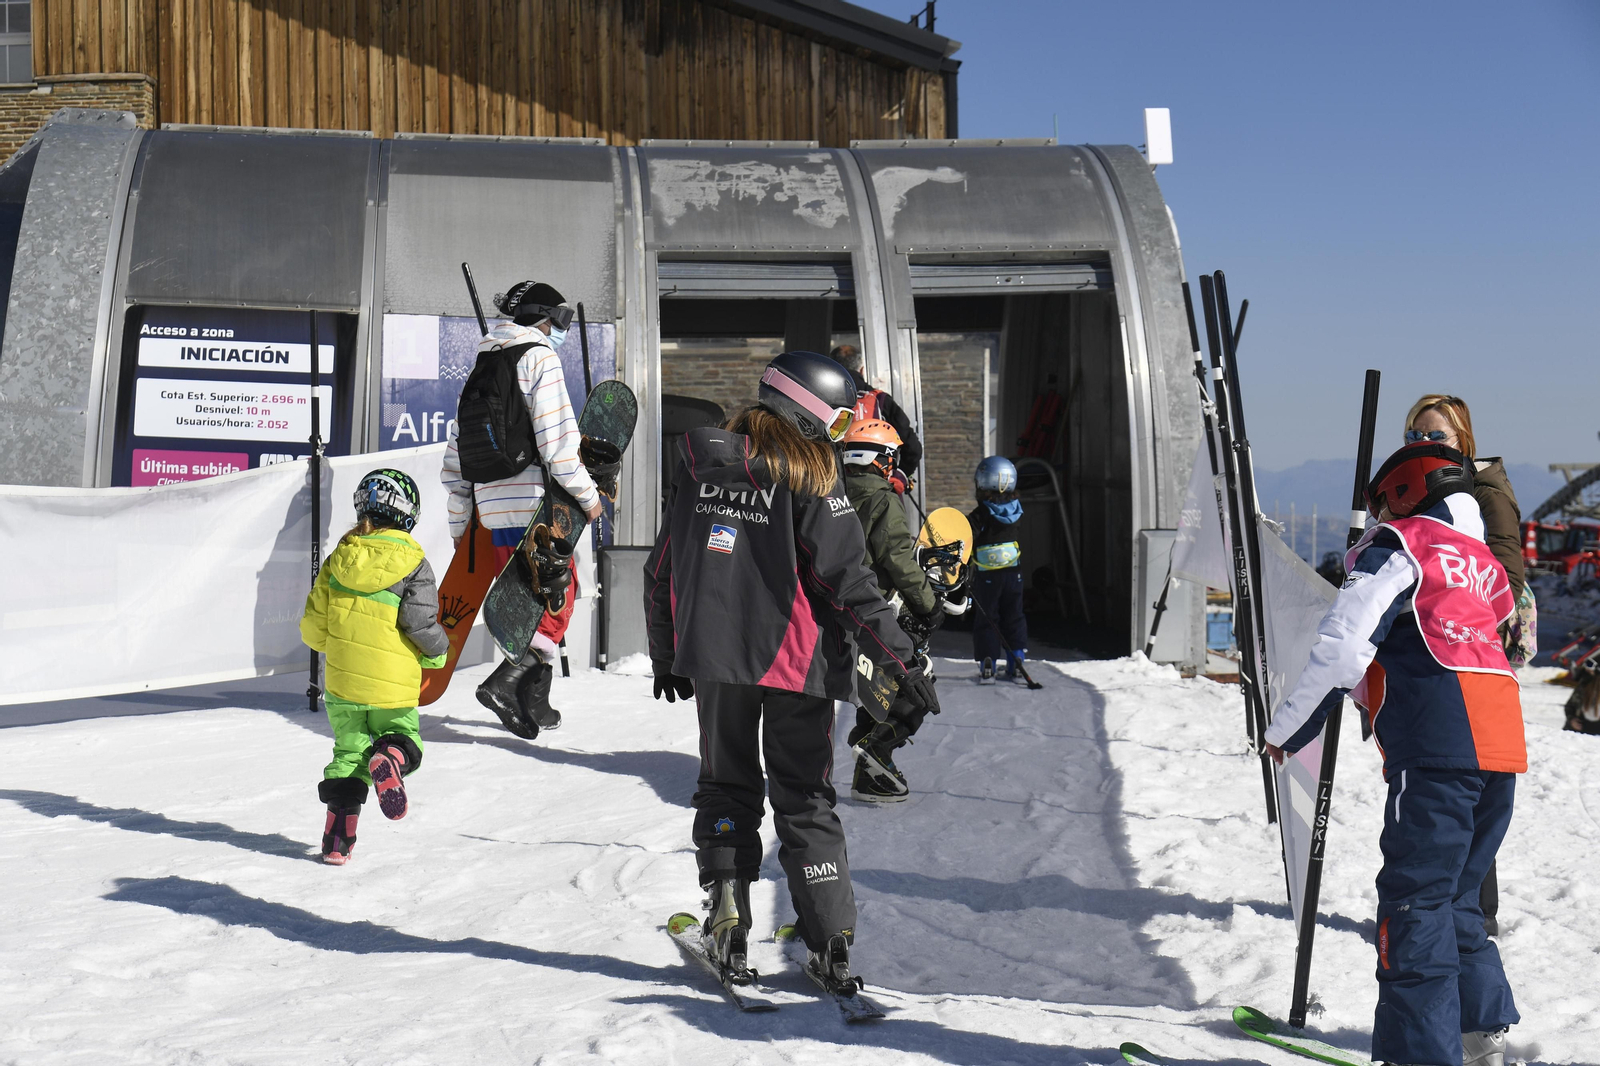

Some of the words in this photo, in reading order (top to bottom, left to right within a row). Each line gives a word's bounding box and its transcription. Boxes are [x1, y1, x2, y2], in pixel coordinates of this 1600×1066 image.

[140, 324, 187, 336] Acceso
[190, 328, 199, 337] a
[202, 328, 234, 338] zona
[180, 346, 290, 364] INICIACIÓN
[161, 390, 184, 399] Cota
[187, 391, 207, 400] Est.
[210, 392, 258, 403] Superior:
[261, 394, 294, 404] 2.696
[195, 404, 243, 415] Desnivel:
[246, 406, 258, 415] 10
[261, 408, 271, 416] m
[176, 416, 254, 428] Usuarios/hora:
[257, 420, 289, 429] 2.052
[140, 457, 188, 475] Última
[827, 495, 853, 511] BM
[695, 502, 769, 525] CAJAGRANADA
[711, 537, 730, 545] sierra
[1238, 550, 1248, 596] LISKI
[1313, 787, 1329, 854] LISKI
[803, 861, 838, 879] BMN
